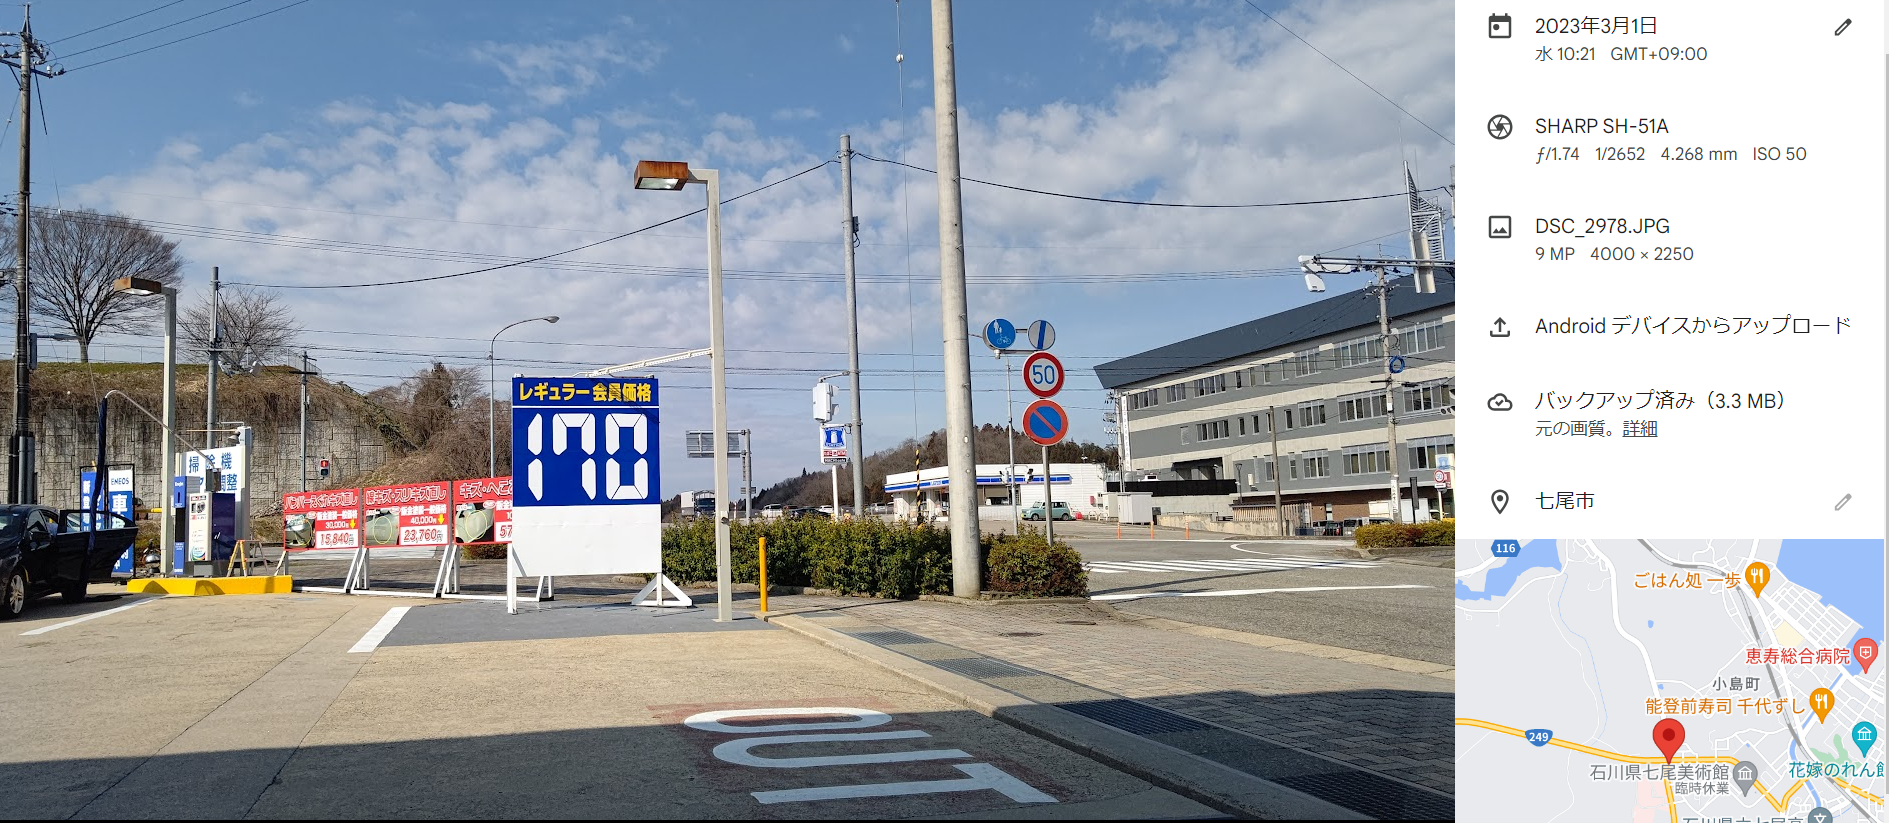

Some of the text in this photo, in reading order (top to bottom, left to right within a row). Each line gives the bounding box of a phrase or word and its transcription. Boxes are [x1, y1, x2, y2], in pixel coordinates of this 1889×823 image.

[1031, 364, 1055, 385] 50
[519, 381, 653, 403] レギュラー 会員価格
[527, 413, 649, 501] 170
[110, 477, 130, 486] ENEOS
[683, 706, 1061, 805] OUT
